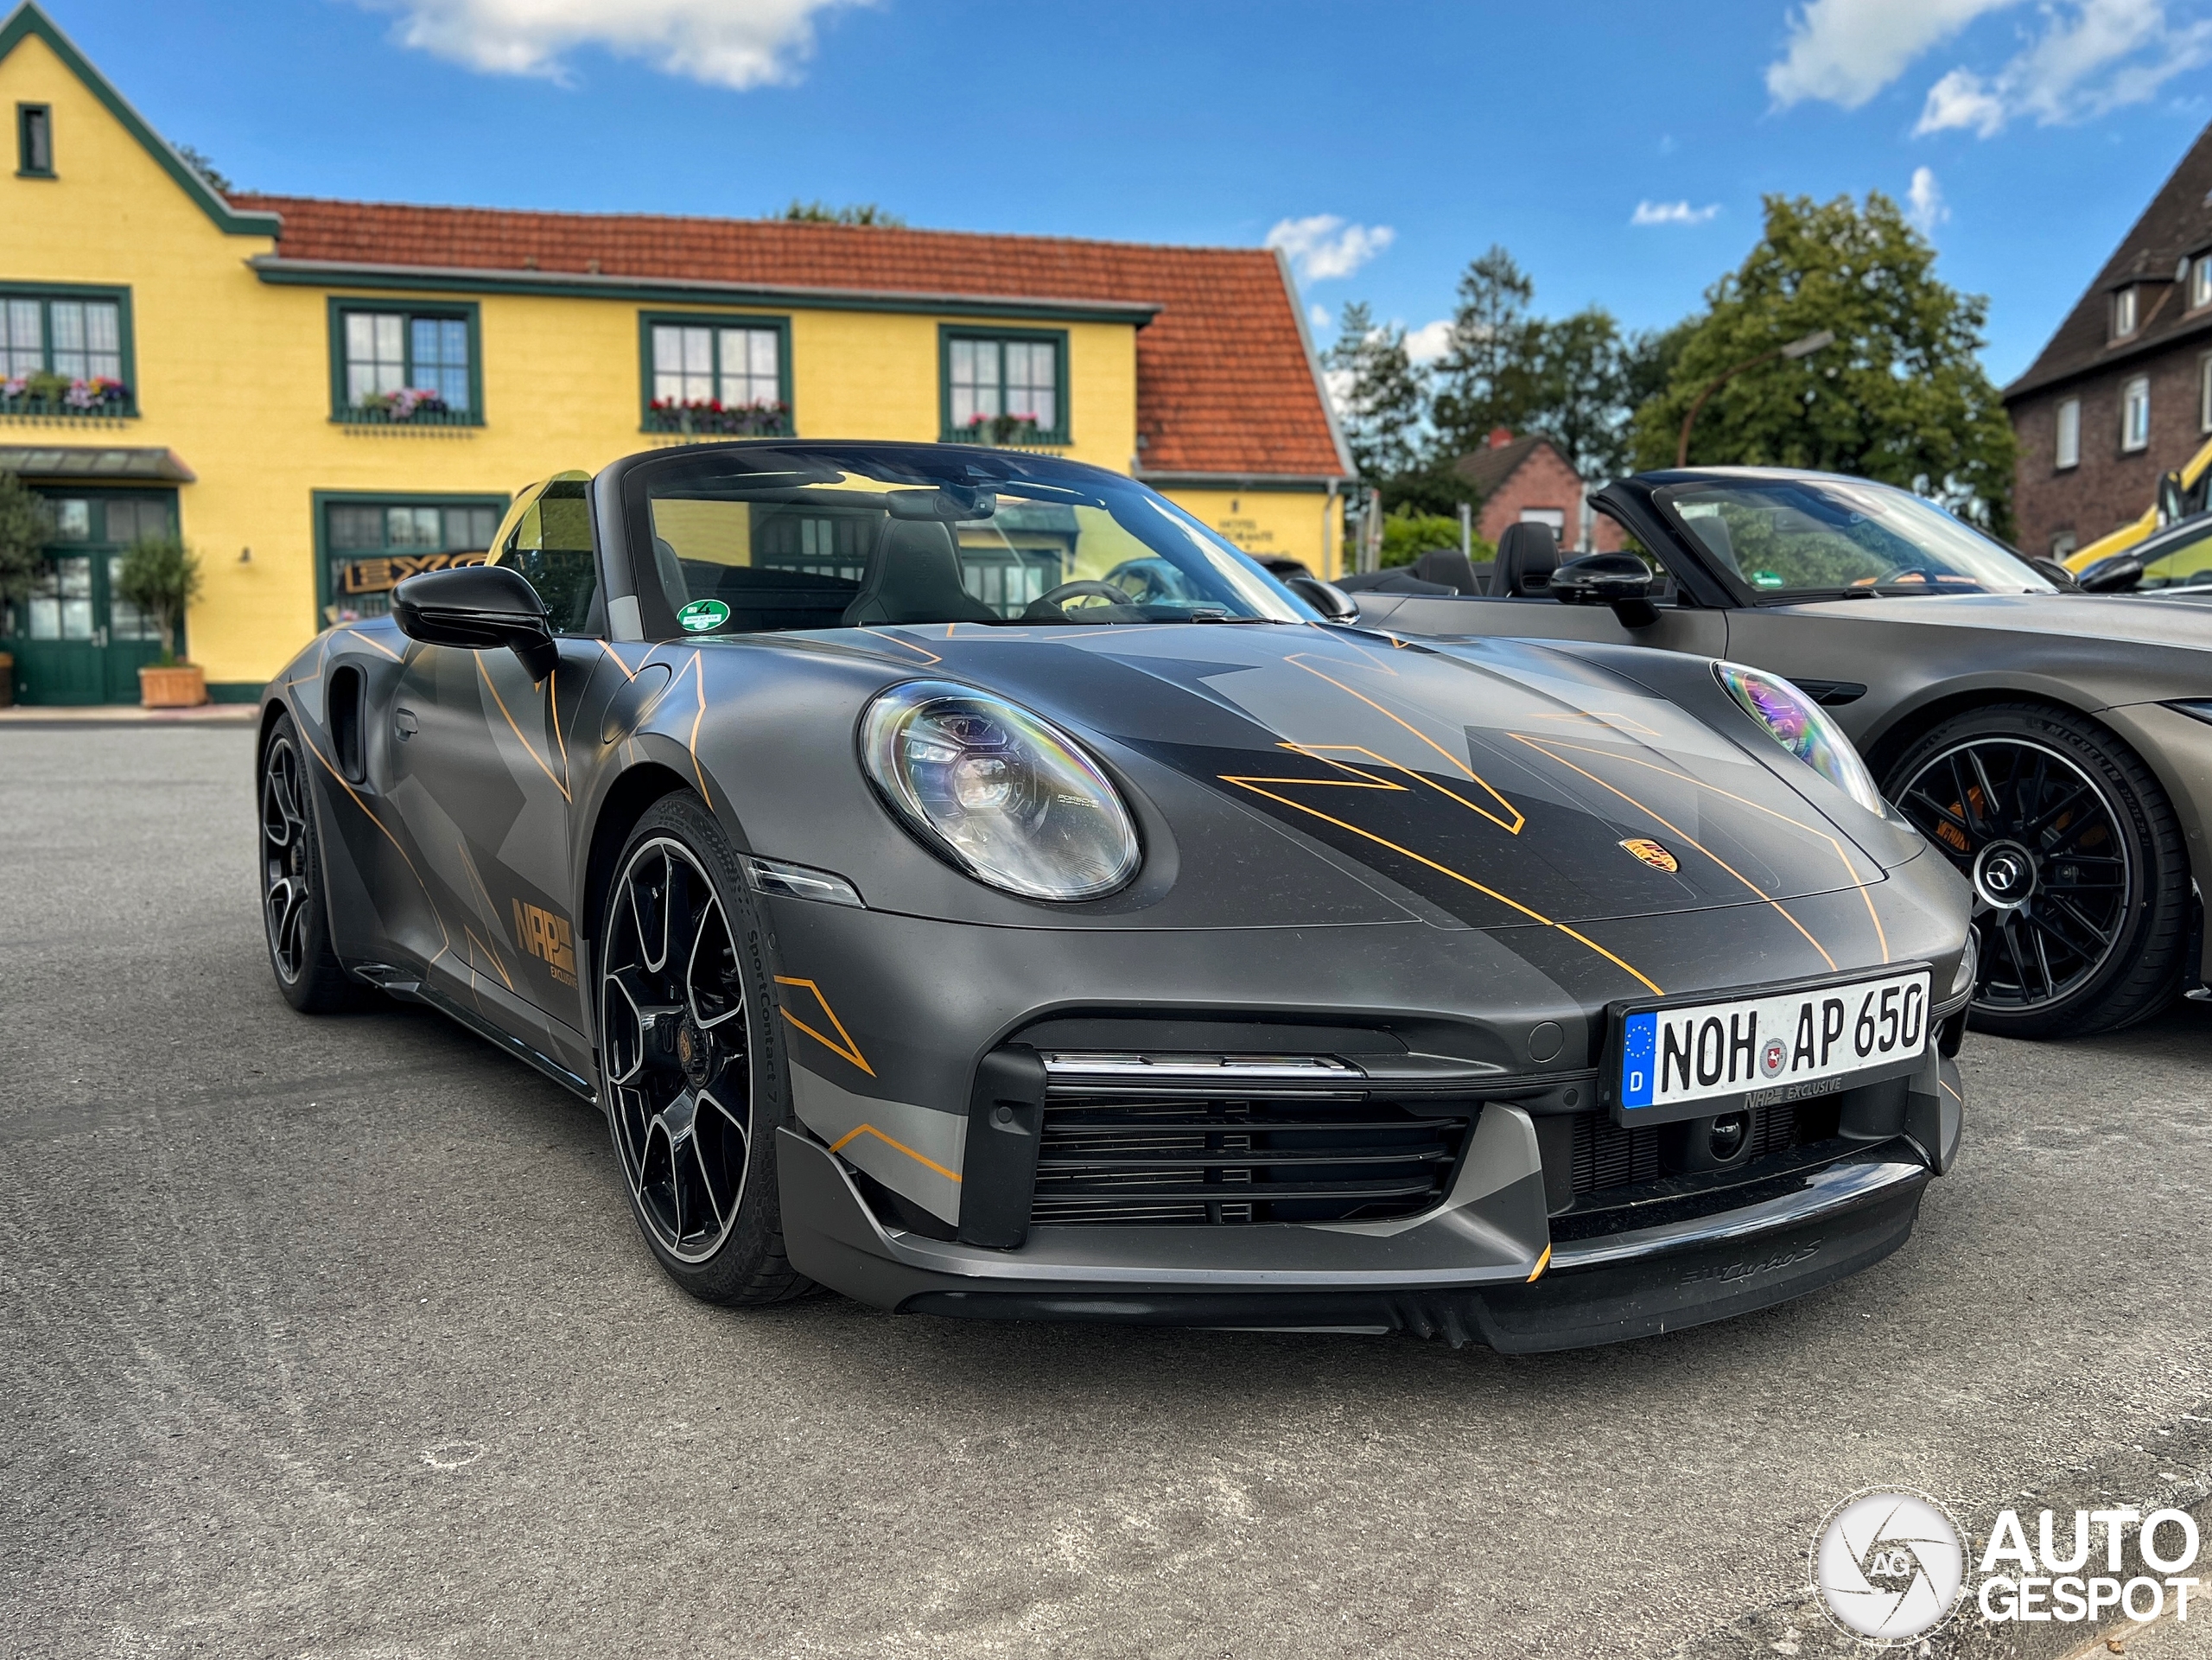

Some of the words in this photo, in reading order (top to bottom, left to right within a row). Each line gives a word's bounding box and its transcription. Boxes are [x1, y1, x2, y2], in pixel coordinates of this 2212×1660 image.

[696, 601, 711, 615] 4
[2047, 724, 2121, 780] MICHELIN
[1058, 794, 1099, 805] PORSCHE
[747, 929, 776, 1081] SportContact
[766, 1091, 778, 1104] 7
[1662, 1009, 1758, 1093] NOH
[1791, 997, 1845, 1072] AP
[1854, 983, 1923, 1058] 650
[1630, 1071, 1643, 1092] D
[1786, 1078, 1842, 1100] EXCLUSIVE
